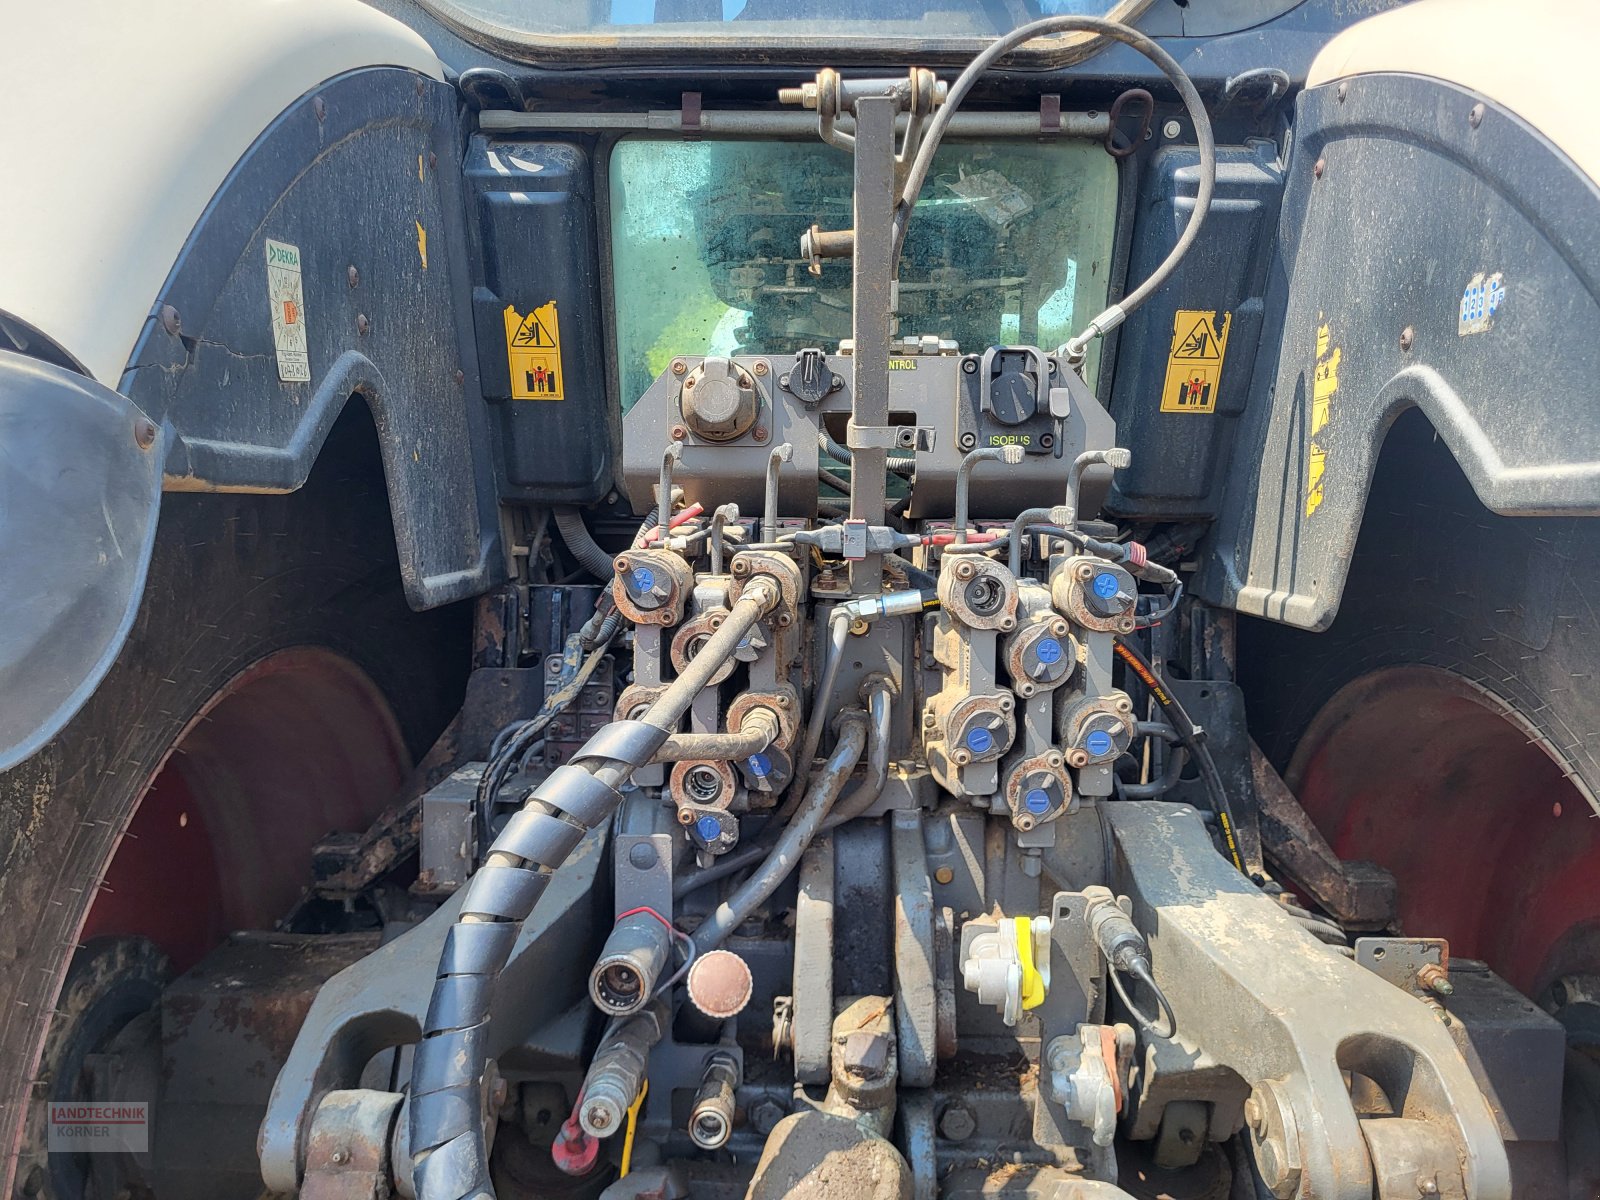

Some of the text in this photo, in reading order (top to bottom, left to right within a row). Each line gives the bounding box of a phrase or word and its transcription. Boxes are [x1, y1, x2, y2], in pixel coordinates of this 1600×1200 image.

[277, 248, 298, 266] DEKRA
[1470, 299, 1475, 309] 2
[1479, 297, 1483, 308] 3
[888, 359, 917, 370] NTROL
